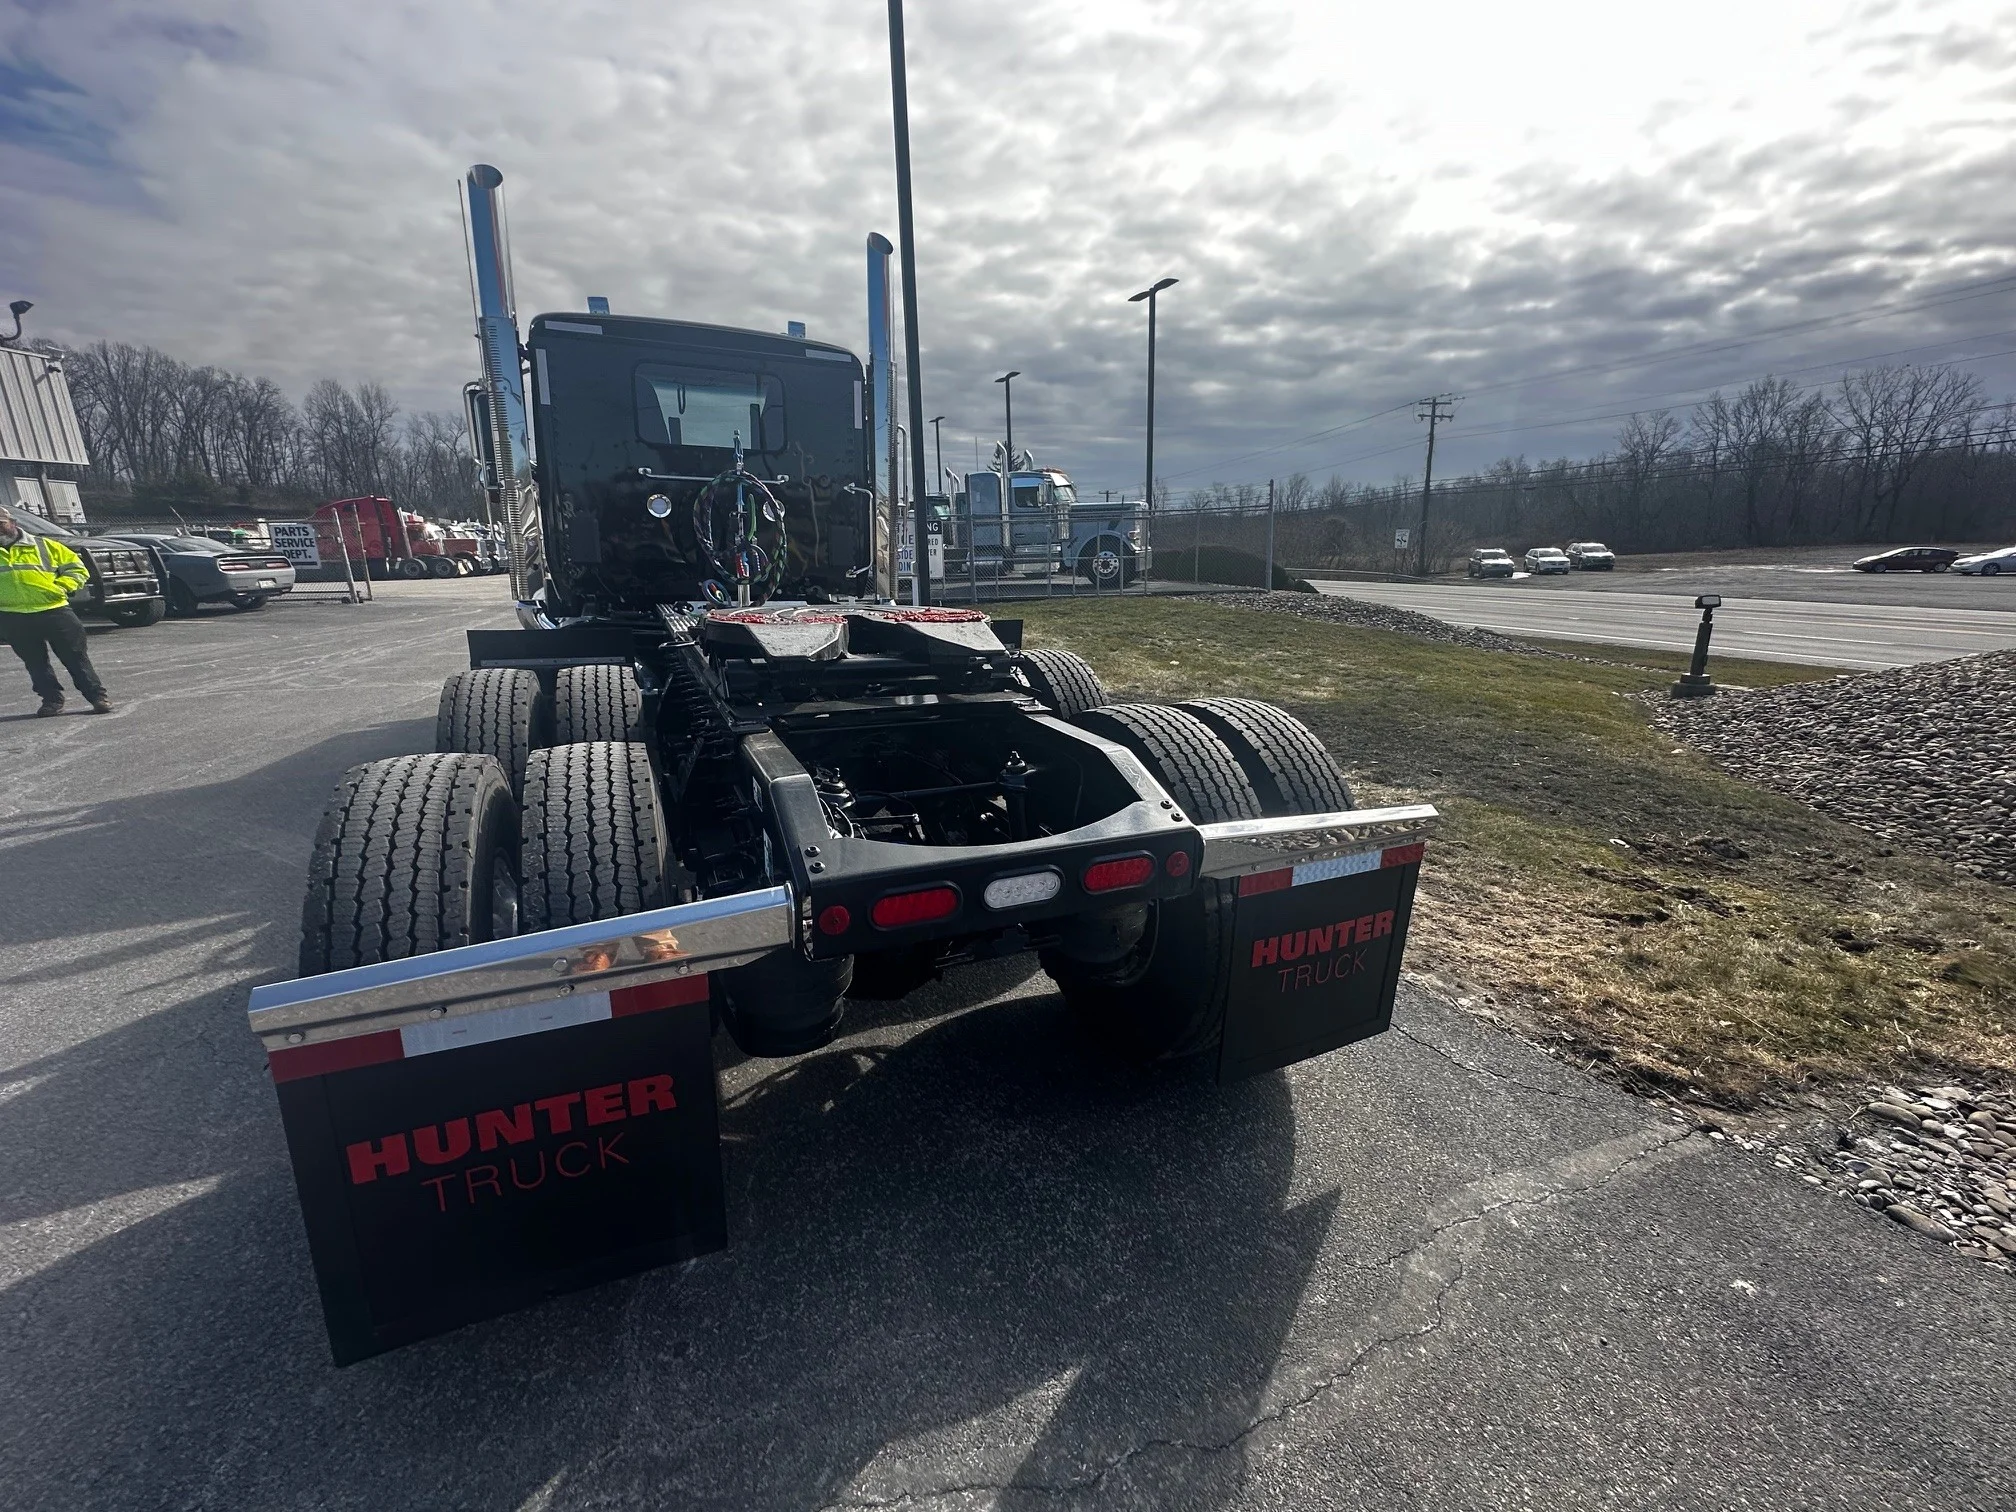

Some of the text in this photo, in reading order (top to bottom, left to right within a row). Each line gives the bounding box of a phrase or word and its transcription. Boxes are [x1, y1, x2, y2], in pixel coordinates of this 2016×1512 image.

[274, 526, 310, 537] PARTS
[274, 537, 315, 548] SERVICE
[283, 549, 312, 559] DEPT.
[1252, 909, 1395, 968] HUNTER
[1277, 948, 1368, 992] TRUCK
[346, 1074, 676, 1184] HUNTER
[420, 1132, 629, 1212] TRUCK
